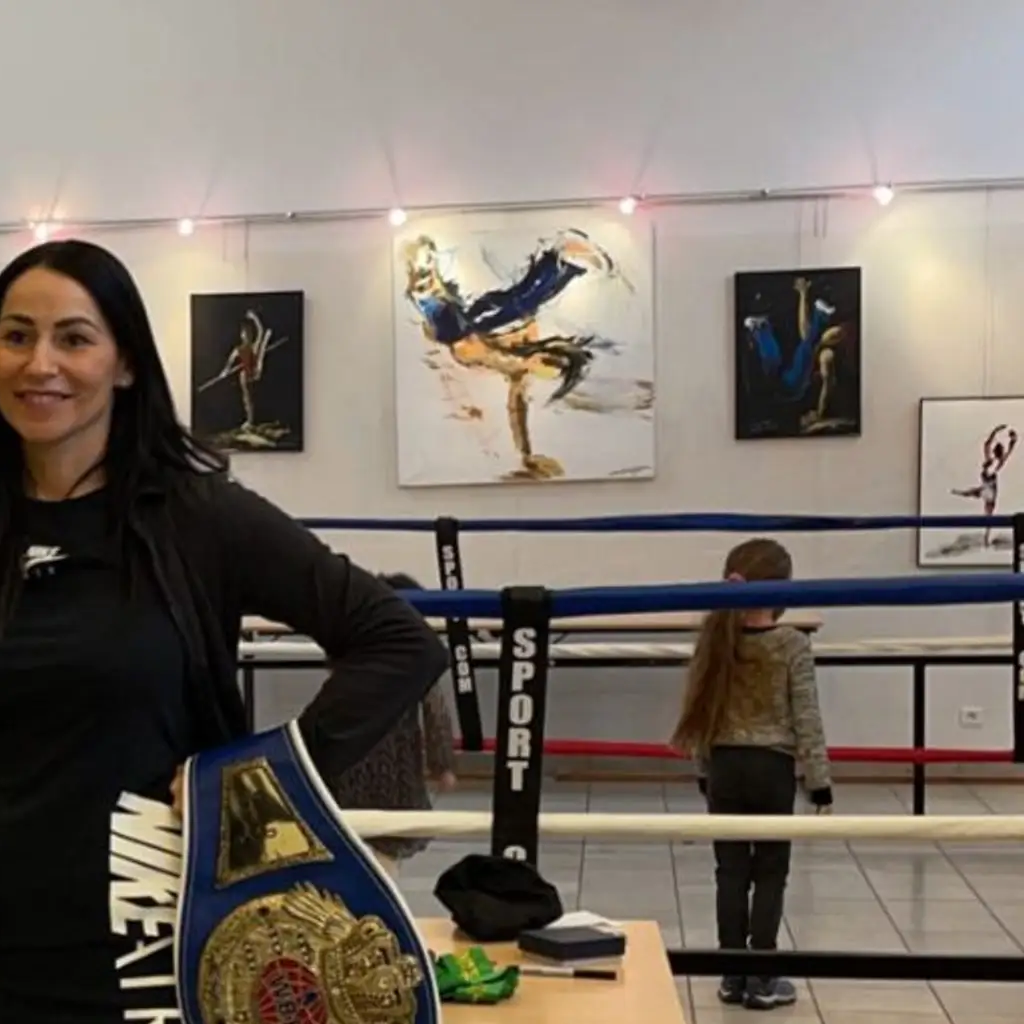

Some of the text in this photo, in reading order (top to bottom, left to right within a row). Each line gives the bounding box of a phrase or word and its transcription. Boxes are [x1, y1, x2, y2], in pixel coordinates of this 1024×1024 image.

[442, 545, 472, 694] SPO COM
[506, 627, 537, 791] SPORT
[109, 790, 182, 937] NIKE
